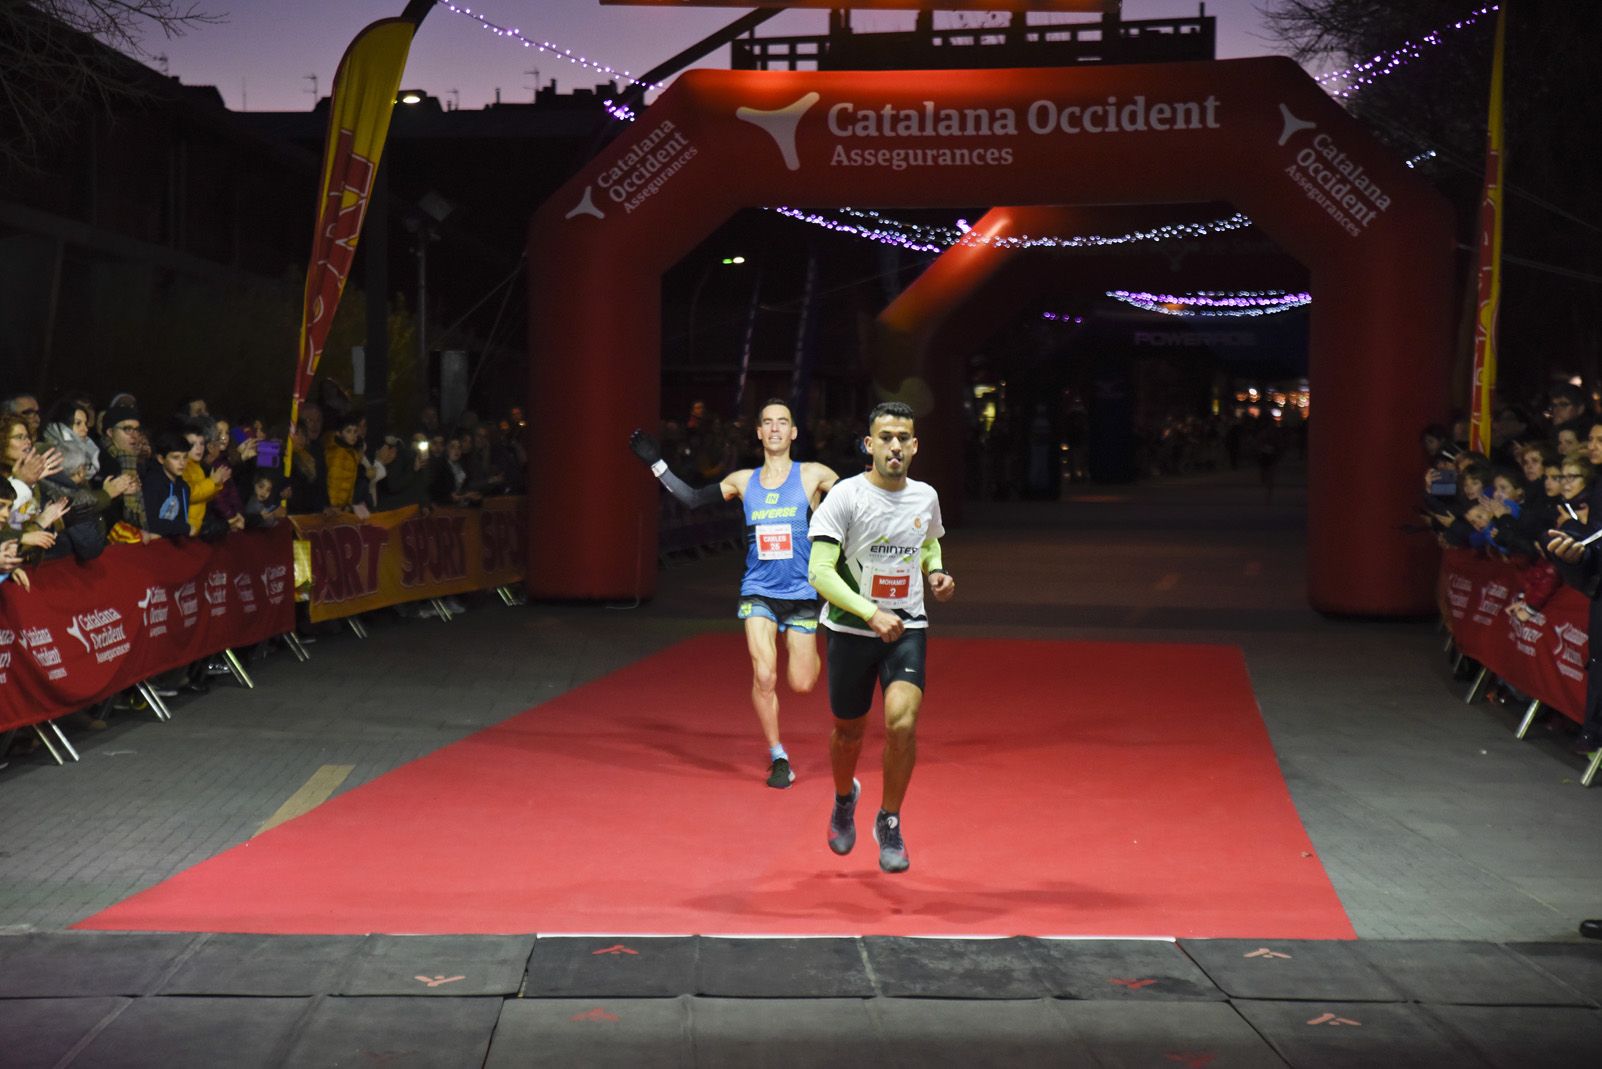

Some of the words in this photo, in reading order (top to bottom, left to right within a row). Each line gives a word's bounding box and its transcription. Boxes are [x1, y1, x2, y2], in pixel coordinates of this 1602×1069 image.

[827, 101, 1018, 137] Catalana
[1027, 94, 1221, 135] Occident
[597, 119, 676, 188] Catalana
[609, 131, 689, 202] Occident
[623, 145, 698, 214] Assegurances
[830, 144, 1014, 170] Assegurances
[1297, 148, 1377, 227] Occident
[1313, 133, 1391, 212] Catalana
[1284, 164, 1361, 237] Assegurances
[751, 506, 798, 521] INVERSE
[889, 588, 897, 597] 2
